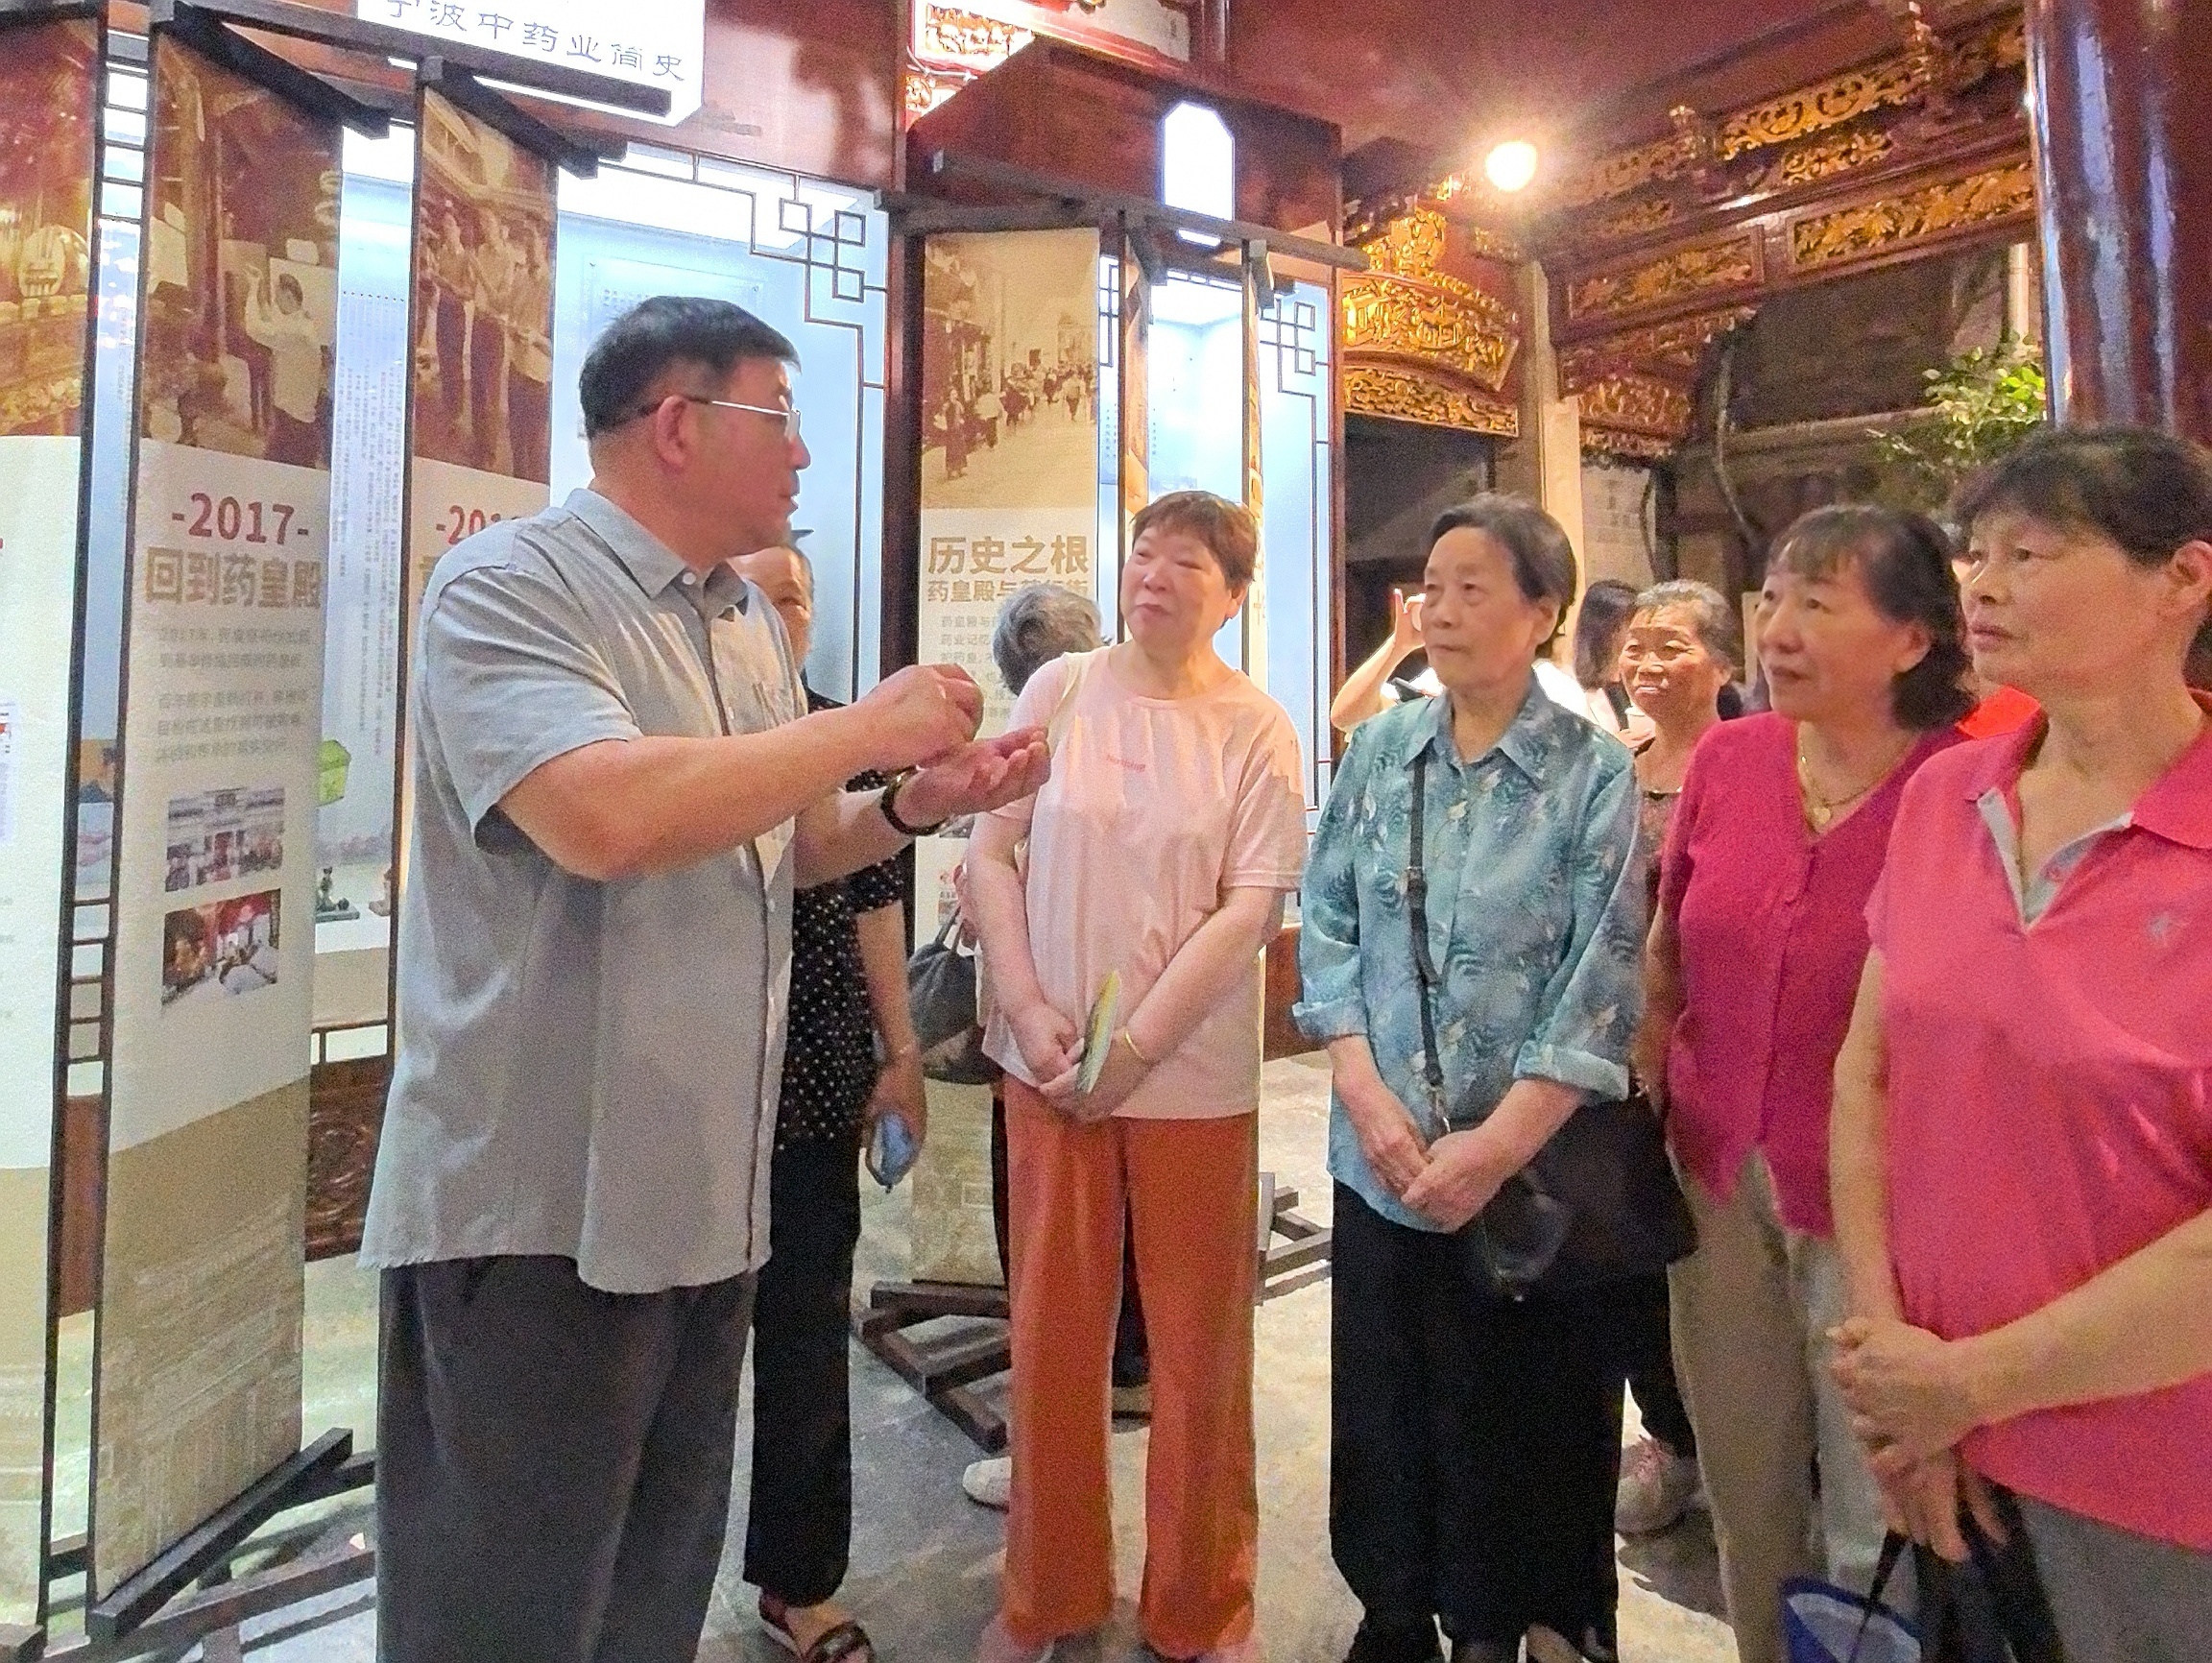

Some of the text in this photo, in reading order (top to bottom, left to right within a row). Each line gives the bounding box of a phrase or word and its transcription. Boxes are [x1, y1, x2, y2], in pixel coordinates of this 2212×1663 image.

[146, 546, 322, 609] 回到药皇殿
[927, 535, 1089, 574] 历史之根
